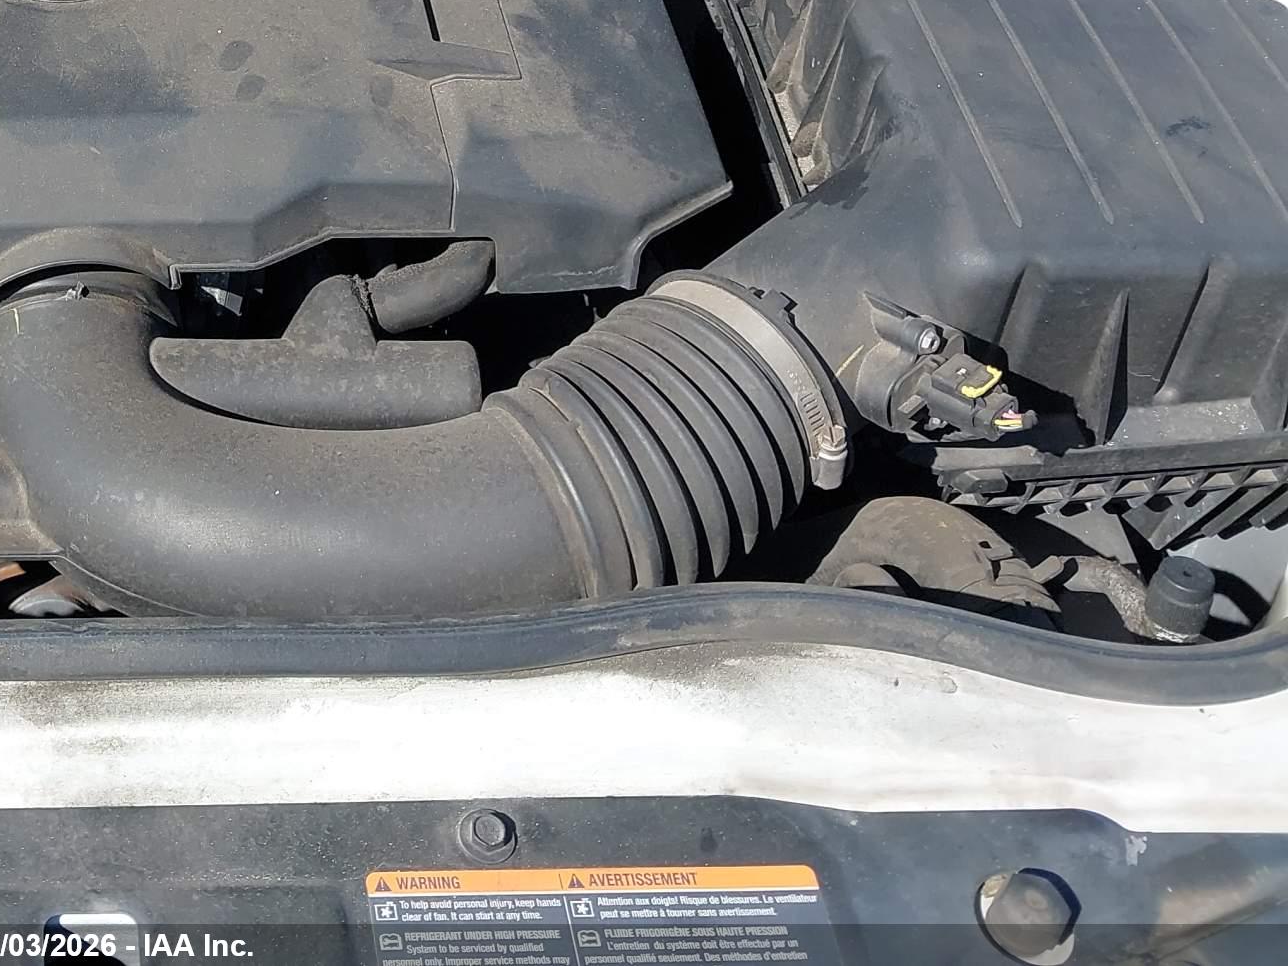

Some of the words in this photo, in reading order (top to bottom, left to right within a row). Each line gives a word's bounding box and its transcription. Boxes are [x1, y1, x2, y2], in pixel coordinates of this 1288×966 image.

[395, 875, 461, 890] WARNING
[589, 872, 698, 887] AVERTISSEMENT
[399, 900, 409, 910] To
[410, 900, 429, 911] help
[430, 899, 452, 909] avoid
[453, 899, 488, 911] personal
[489, 898, 514, 911] injury,
[515, 899, 535, 910] keep
[536, 897, 562, 908] hands
[597, 896, 634, 906] Attention
[635, 897, 650, 906] aux
[651, 896, 679, 907] doigts!
[680, 895, 708, 906] Risque
[708, 895, 720, 905] de
[720, 895, 763, 905] blessures.
[763, 894, 774, 904] Le
[774, 893, 817, 903] ventilateur
[401, 911, 420, 922] clear
[421, 911, 432, 922] of
[432, 911, 450, 922] fan.
[451, 911, 458, 921] It
[458, 912, 474, 922] can
[475, 910, 493, 921] start
[494, 910, 505, 920] at
[506, 912, 521, 922] any
[521, 909, 542, 920] time.
[599, 909, 619, 920] peut
[619, 910, 631, 918] se
[631, 908, 658, 918] mettre
[666, 908, 696, 918] tourner
[697, 908, 718, 917] sans
[718, 907, 777, 917] avertissement.
[404, 931, 462, 942] REFRIGERANT
[463, 930, 493, 941] UNDER
[494, 930, 515, 940] HIGH
[517, 929, 561, 939] PRESSURE
[604, 928, 634, 938] FLUIDE
[635, 926, 691, 938] FRIGORIGÈNE
[692, 927, 715, 937] SOUS
[716, 926, 745, 936] HAUTE
[745, 925, 789, 936] PRESSION
[406, 944, 437, 954] System
[438, 944, 448, 953] to
[449, 943, 460, 953] be
[461, 943, 496, 953] serviced
[496, 942, 508, 954] by
[509, 941, 544, 953] qualified
[607, 941, 650, 951] L'entretien
[653, 941, 665, 950] du
[665, 940, 700, 951] système
[701, 940, 718, 949] doit
[718, 939, 736, 949] être
[736, 938, 771, 948] effectué
[771, 940, 785, 950] par
[787, 939, 799, 948] un
[445, 956, 482, 966] Improper
[483, 956, 514, 966] service
[515, 955, 551, 966] methods
[552, 956, 570, 966] may
[584, 954, 625, 966] personnel
[626, 953, 657, 965] qualifié
[658, 953, 703, 963] seulement.
[704, 952, 721, 962] Des
[721, 951, 763, 962] méthodes
[763, 951, 808, 961] d'entretien
